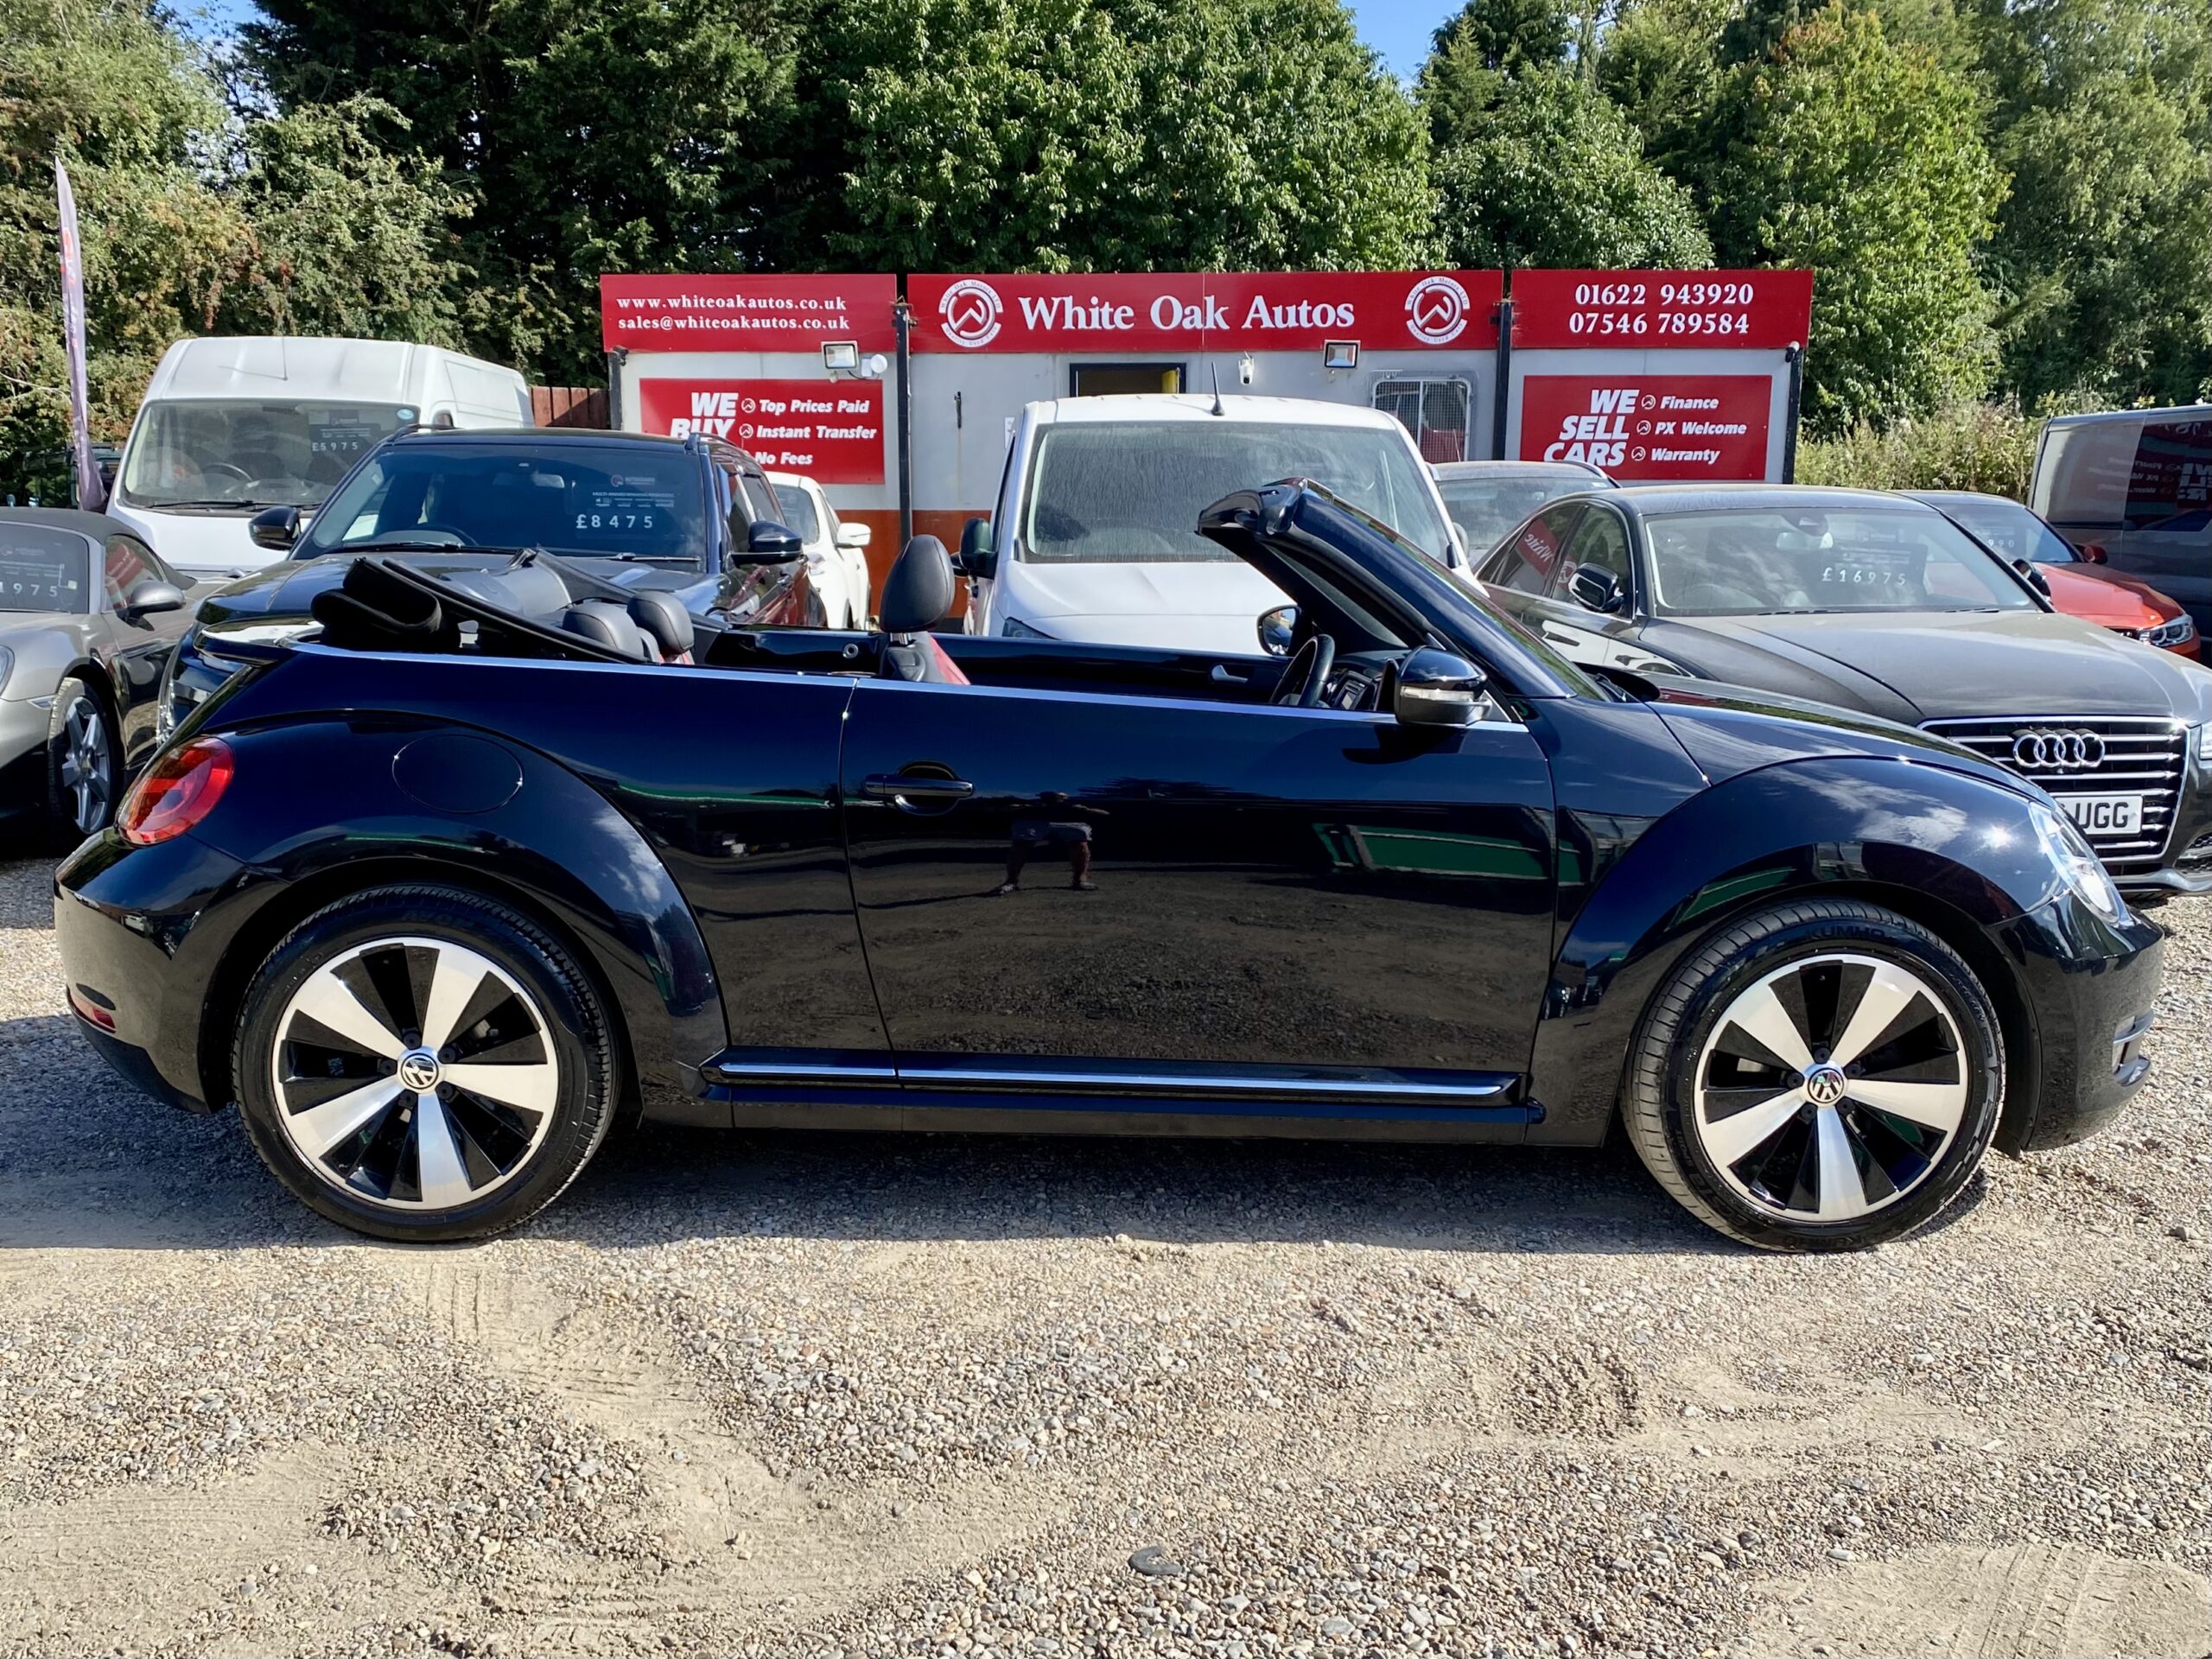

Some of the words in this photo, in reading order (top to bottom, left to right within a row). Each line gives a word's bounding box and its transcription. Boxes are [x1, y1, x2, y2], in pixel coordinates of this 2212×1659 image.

[616, 294, 847, 310] www.whiteoakautos.co.uk
[1575, 283, 1646, 305] 01622
[1660, 283, 1754, 306] 943920
[1018, 296, 1135, 330] White
[1149, 295, 1230, 331] Oak
[1242, 296, 1355, 329] Autos
[618, 315, 850, 331] sales@whiteoakautos.co.uk
[1569, 313, 1648, 334] 07546
[1658, 312, 1750, 335] 789584
[690, 391, 740, 417] WE
[759, 399, 786, 416] Top
[790, 399, 833, 414] Prices
[836, 399, 870, 414] Paid
[1590, 389, 1640, 414] WE
[1660, 396, 1719, 410] Finance
[756, 424, 810, 439] Instant
[816, 425, 877, 440] Transfer
[1559, 415, 1630, 441] SELL
[1655, 422, 1675, 435] PX
[1681, 421, 1747, 435] Welcome
[754, 451, 778, 466] No
[779, 451, 813, 466] Fees
[1543, 442, 1627, 467] CARS
[1650, 448, 1721, 465] Warranty
[575, 514, 653, 529] £8475
